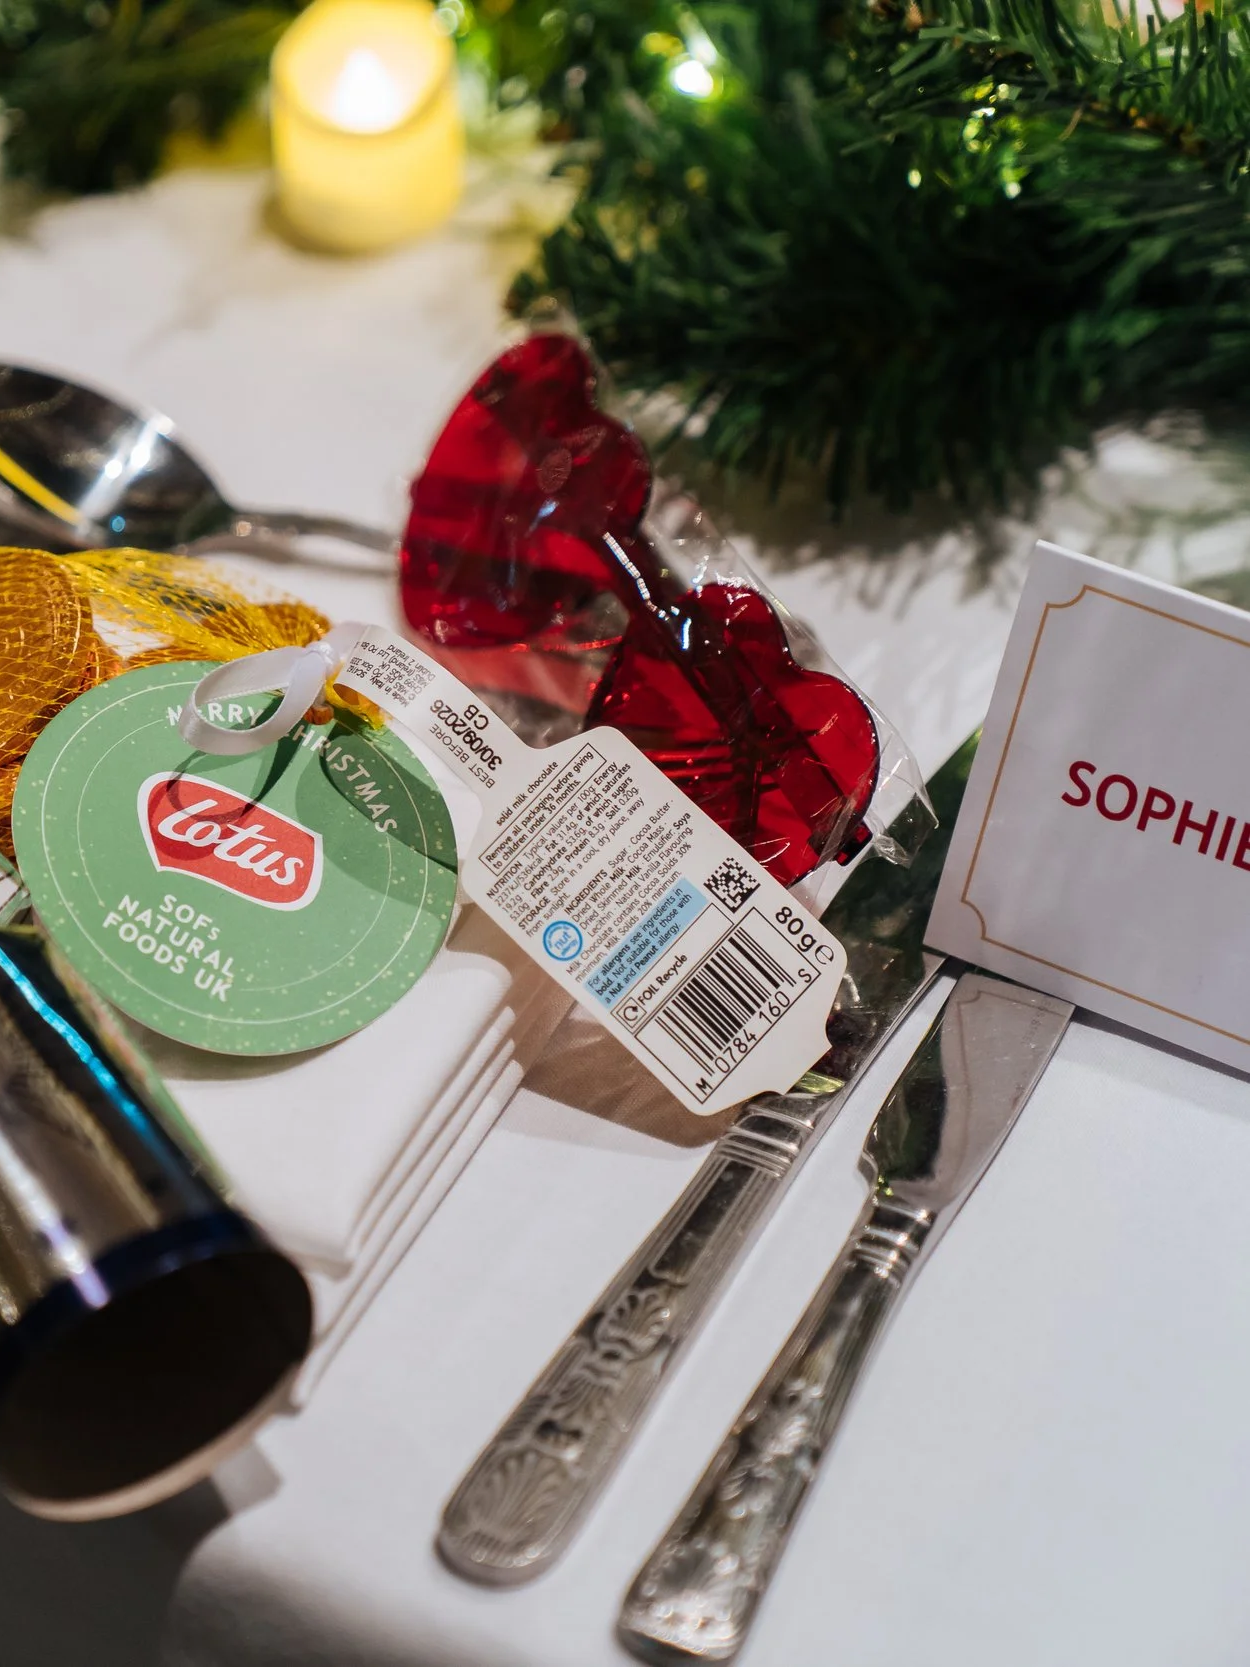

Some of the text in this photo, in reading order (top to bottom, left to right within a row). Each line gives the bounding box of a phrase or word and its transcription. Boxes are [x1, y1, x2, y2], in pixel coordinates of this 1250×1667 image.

[360, 660, 374, 672] Box
[366, 643, 379, 654] PO
[368, 672, 385, 689] Italy.
[371, 666, 384, 678] PO
[375, 648, 390, 660] Ltd
[377, 660, 391, 672] UK
[382, 673, 396, 684] plc
[383, 685, 392, 695] in
[385, 643, 436, 681] Dublin 2 Ireland
[387, 654, 416, 677] (Ireland)
[390, 690, 407, 707] Made
[429, 699, 502, 771] 30/09/2026
[462, 703, 489, 731] CB
[167, 702, 398, 833] MRRY HRISTMAS
[428, 722, 496, 789] BEST BEFORE
[495, 760, 559, 826] solid milk chocolate
[157, 799, 305, 886] Lotus
[484, 750, 594, 863] Remove all packaging before giving
[485, 859, 523, 899] NUTRITION
[521, 834, 548, 860] Typical
[545, 814, 568, 836] values
[565, 801, 580, 817] per
[592, 760, 618, 786] Energy
[491, 779, 581, 870] to children under 36 months.
[522, 845, 568, 891] Carbohydrate
[584, 814, 594, 827] of
[591, 797, 613, 818] which
[610, 775, 633, 799] sugars
[543, 838, 559, 853] Fat
[555, 820, 579, 841] 31.4g,
[575, 808, 585, 821] of
[582, 790, 603, 812] which
[601, 762, 631, 794] saturates
[517, 796, 645, 930] STORAGE Store in a cool, dry place, away
[529, 880, 550, 899] Fibre
[546, 864, 565, 882] 2.9g
[563, 837, 590, 863] Protein
[587, 821, 605, 839] 8.3g
[604, 803, 621, 820] Salt
[563, 801, 670, 915] INGREDIENTS Sugar Cocoa Butter
[570, 824, 665, 923] Dried Whole Milk Cocoa Mass
[578, 908, 600, 930] Dried
[596, 877, 628, 912] Skimmed
[624, 864, 642, 881] Milk
[672, 811, 691, 830] Soya
[586, 826, 694, 938] Lecithin Natural Vanilla Flavouring.
[118, 895, 234, 978] NATURAL
[524, 919, 544, 937] from
[542, 891, 571, 920] sunlight.
[565, 841, 692, 975] Milk Chocolate contains Cocoa Solids 30%
[574, 869, 682, 983] minimum, Milk Solids 20% minimum.
[586, 887, 683, 989] For allergens see ingredients in
[594, 893, 692, 996] bold. Not suitable for those with
[102, 911, 232, 1002] FOODS UK
[604, 921, 680, 1004] a Nut and Peanut allergy.
[636, 953, 688, 1006] FOIL Recycle
[695, 967, 812, 1095] M 0784 160 S
